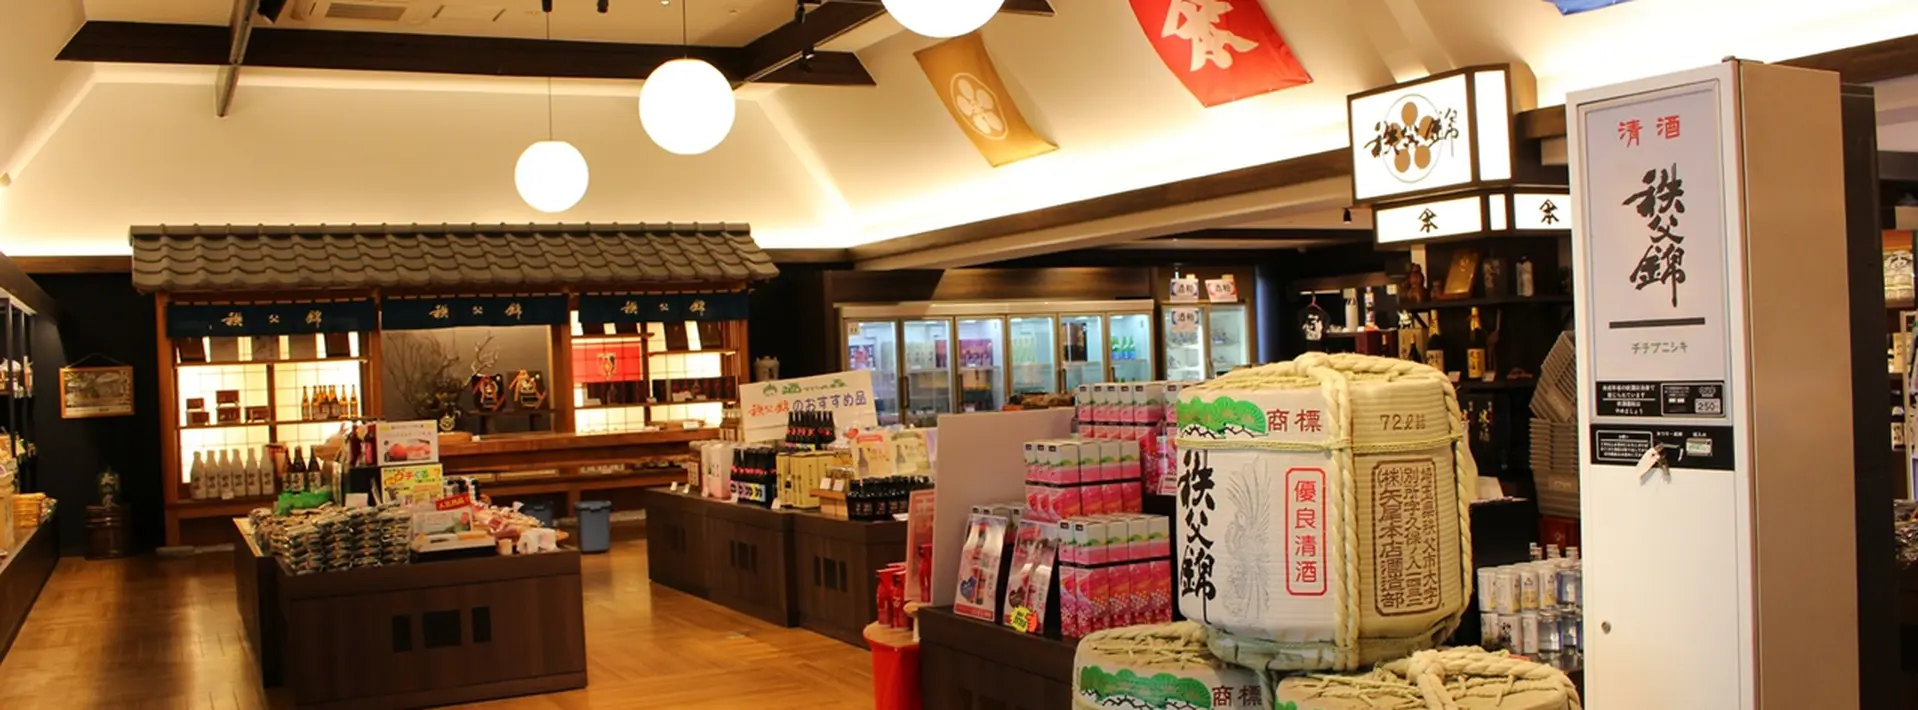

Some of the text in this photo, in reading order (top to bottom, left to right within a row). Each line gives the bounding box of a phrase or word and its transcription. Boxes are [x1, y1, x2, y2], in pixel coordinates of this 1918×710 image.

[1364, 107, 1459, 157] 秩父錦
[1617, 115, 1681, 148] 清酒
[1621, 163, 1686, 308] 秩父錦
[1266, 409, 1323, 433] 商標
[1293, 480, 1317, 584] 優良清酒
[1212, 685, 1263, 706] 商標
